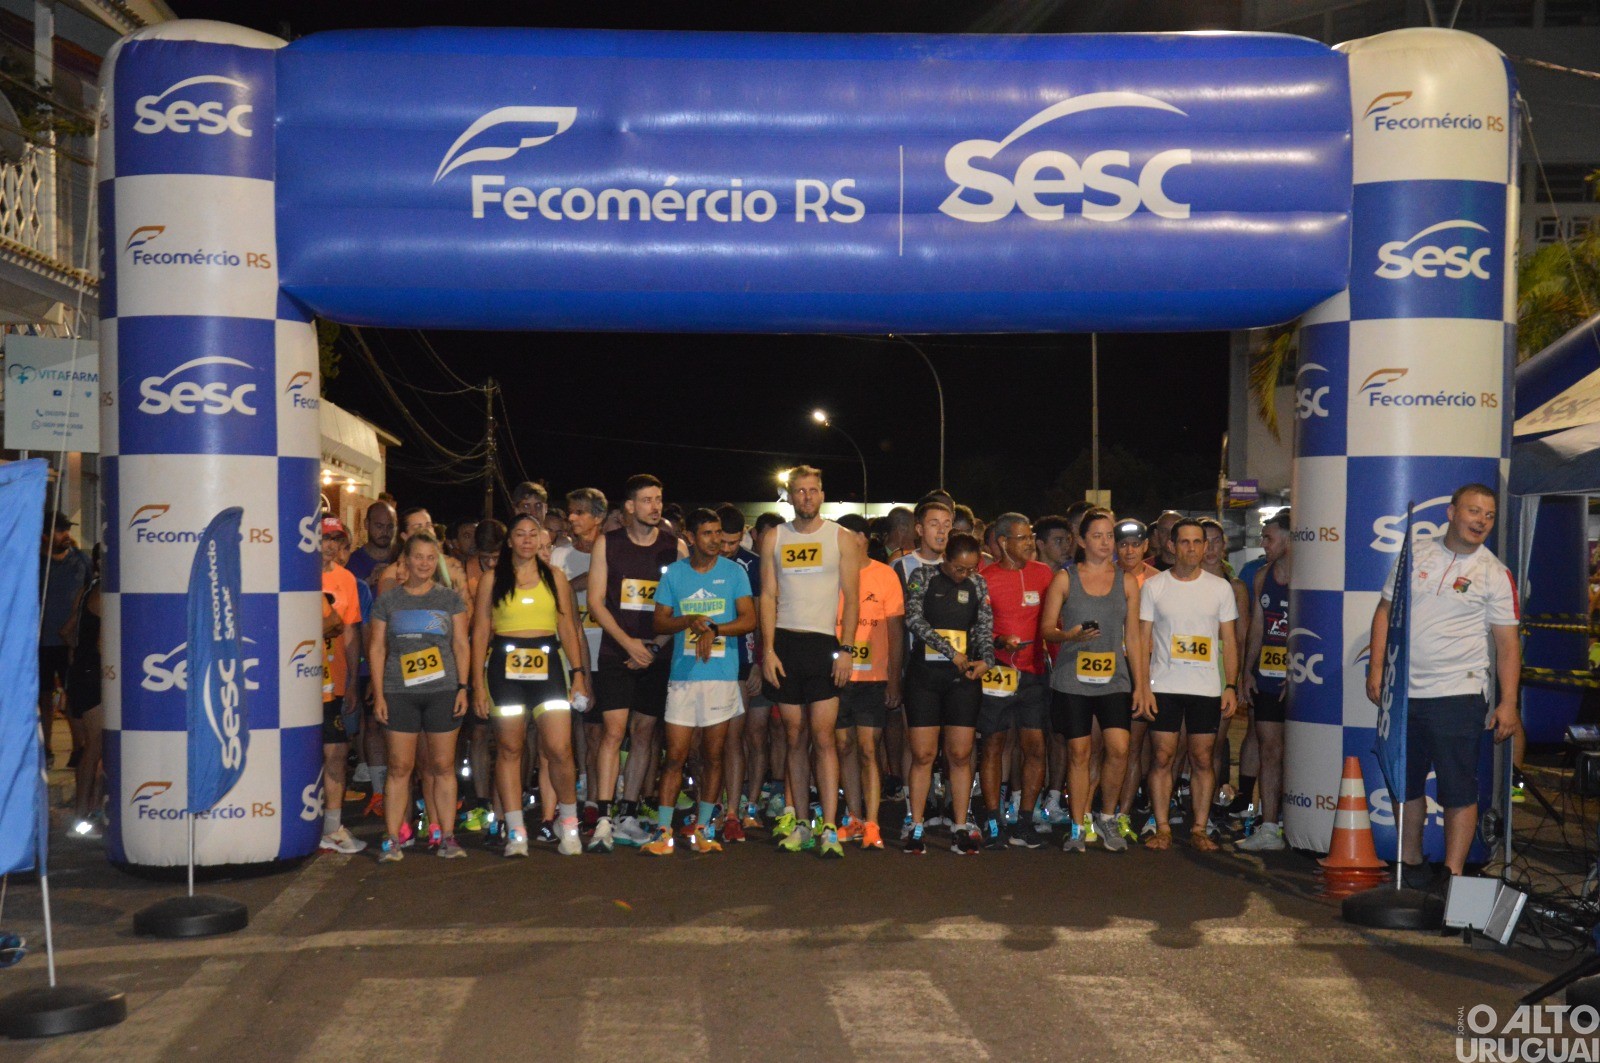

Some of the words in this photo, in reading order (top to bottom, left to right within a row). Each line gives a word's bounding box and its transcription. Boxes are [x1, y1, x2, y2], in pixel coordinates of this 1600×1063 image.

[133, 94, 253, 137] Sesc
[1375, 113, 1482, 131] Fecomércio
[1487, 115, 1505, 132] RS
[938, 138, 1192, 223] Sesc
[471, 174, 777, 222] Fecomércio
[795, 178, 866, 223] RS
[133, 249, 240, 268] Fecomércio
[246, 251, 272, 270] RS
[1374, 239, 1491, 280] Sesc
[138, 376, 257, 416] Sesc
[1369, 391, 1476, 407] Fecomércio
[1481, 392, 1498, 408] RS
[250, 527, 273, 543] RS
[1319, 526, 1339, 542] RS
[786, 548, 818, 562] 347
[207, 539, 222, 641] Fecomércio
[626, 585, 656, 599] 342
[1176, 641, 1207, 655] 346
[406, 654, 438, 673] 293
[512, 654, 544, 668] 320
[1081, 657, 1112, 671] 262
[983, 670, 1011, 685] 341
[218, 658, 242, 770] Sesc
[252, 802, 275, 818] RS
[1316, 795, 1337, 811] RS
